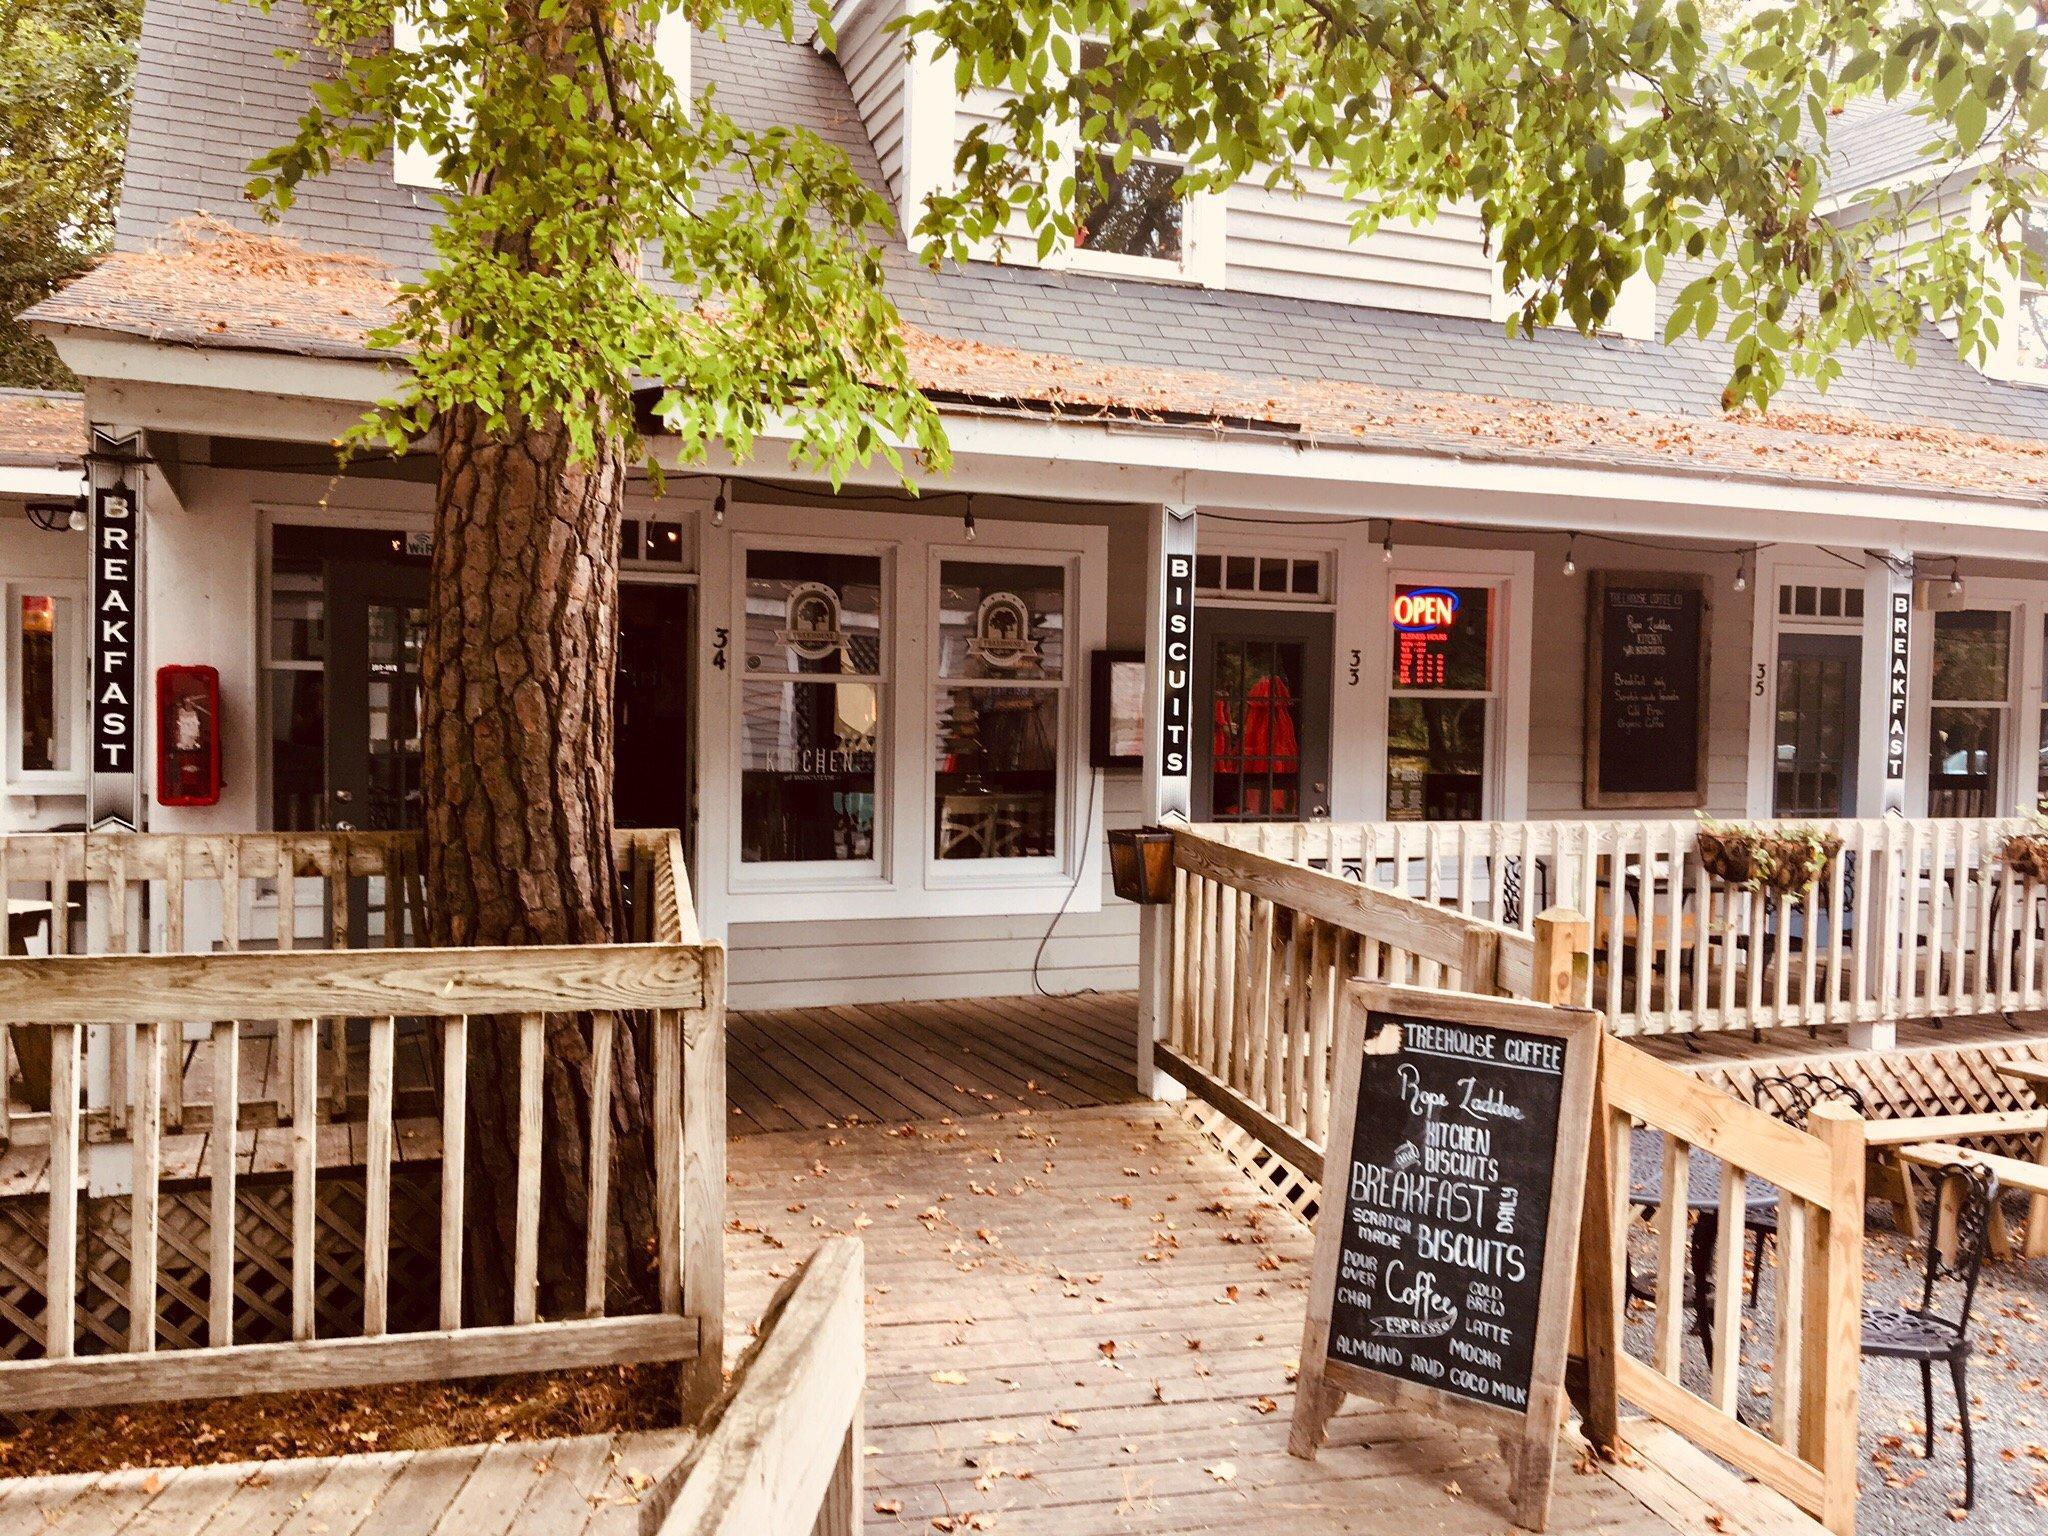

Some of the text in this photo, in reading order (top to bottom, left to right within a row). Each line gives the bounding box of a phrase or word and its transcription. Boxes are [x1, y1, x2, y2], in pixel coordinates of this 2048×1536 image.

[1394, 595, 1452, 625] OPEN
[101, 495, 129, 766] BREAKFAST
[713, 627, 729, 670] 34
[1167, 559, 1189, 771] BISCUITS
[1348, 649, 1361, 686] 33
[1755, 663, 1766, 697] 35
[1889, 597, 1908, 776] BREAKFAST
[765, 748, 854, 773] KTCHEN
[1403, 1023, 1562, 1071] TREEHOUSE COFFEE
[1397, 1063, 1526, 1121] Rope Ladder
[1425, 1119, 1491, 1156] KITCHEN
[1425, 1146, 1499, 1183] BISCUITS
[1351, 1161, 1490, 1229] BREAKFAST
[1496, 1186, 1519, 1235] DAILY
[1352, 1207, 1412, 1235] SCRATCH
[1358, 1225, 1402, 1250] MADE
[1343, 1249, 1379, 1273] POUR
[1418, 1223, 1526, 1283] BISCUITS
[1341, 1266, 1376, 1290] OVER
[1385, 1259, 1458, 1322] Coffee
[1468, 1280, 1503, 1300] COLD
[1337, 1286, 1372, 1310] CHAI
[1466, 1294, 1506, 1317] BREW
[1385, 1315, 1450, 1336] ESPRESSO
[1465, 1317, 1513, 1346] LATTE
[1449, 1337, 1502, 1371] MOCHA
[1410, 1353, 1445, 1380] AND
[1449, 1367, 1490, 1395] COCO
[1491, 1380, 1528, 1405] MILK
